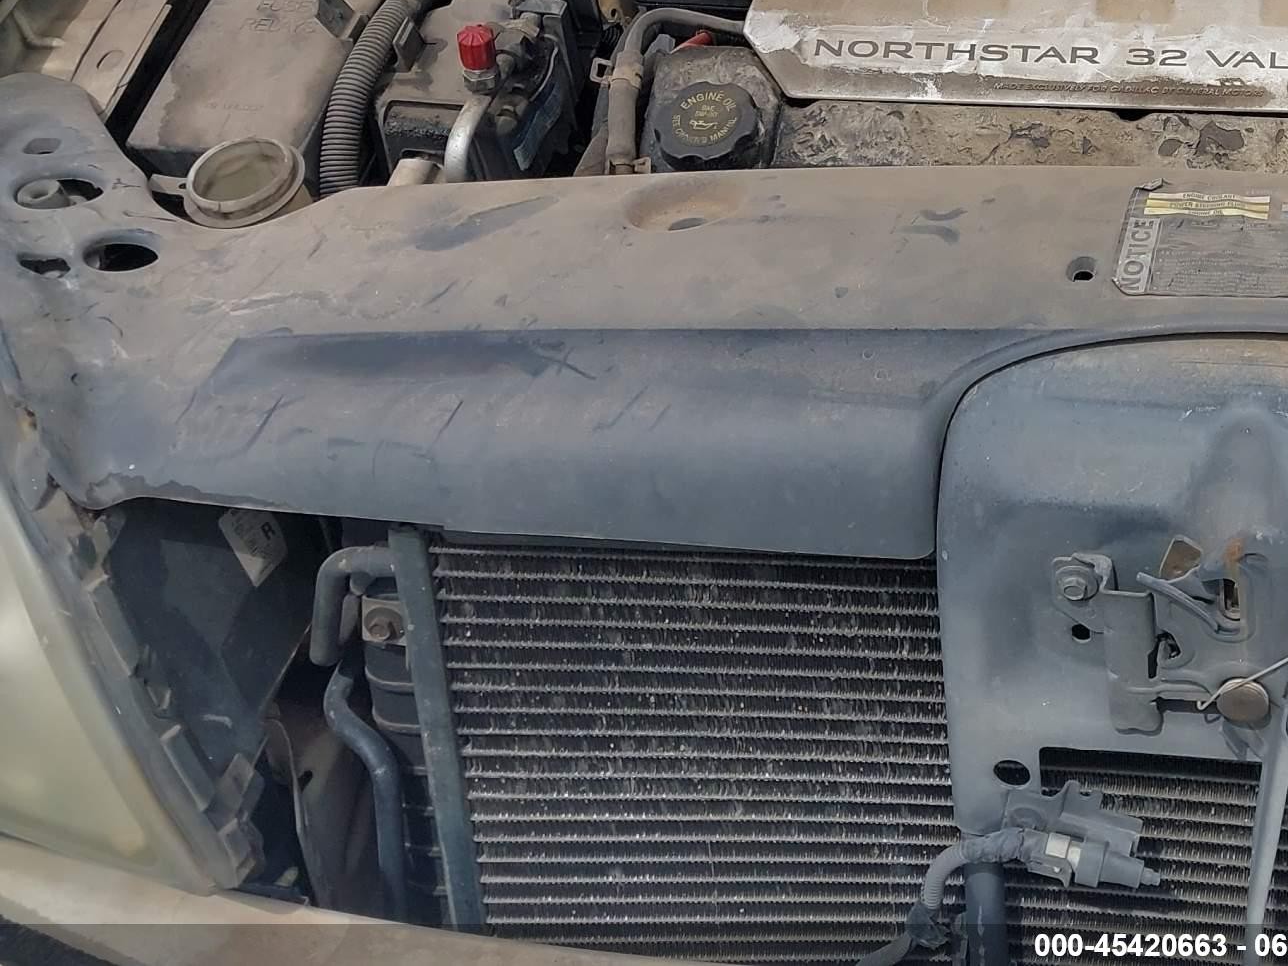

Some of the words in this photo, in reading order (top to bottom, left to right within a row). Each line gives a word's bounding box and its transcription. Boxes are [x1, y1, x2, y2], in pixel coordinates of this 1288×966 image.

[814, 39, 1100, 65] NORTHSTAR
[1126, 48, 1187, 67] 32
[680, 91, 725, 109] ENGINE
[722, 97, 737, 112] OIL
[1120, 219, 1154, 290] NOTICE
